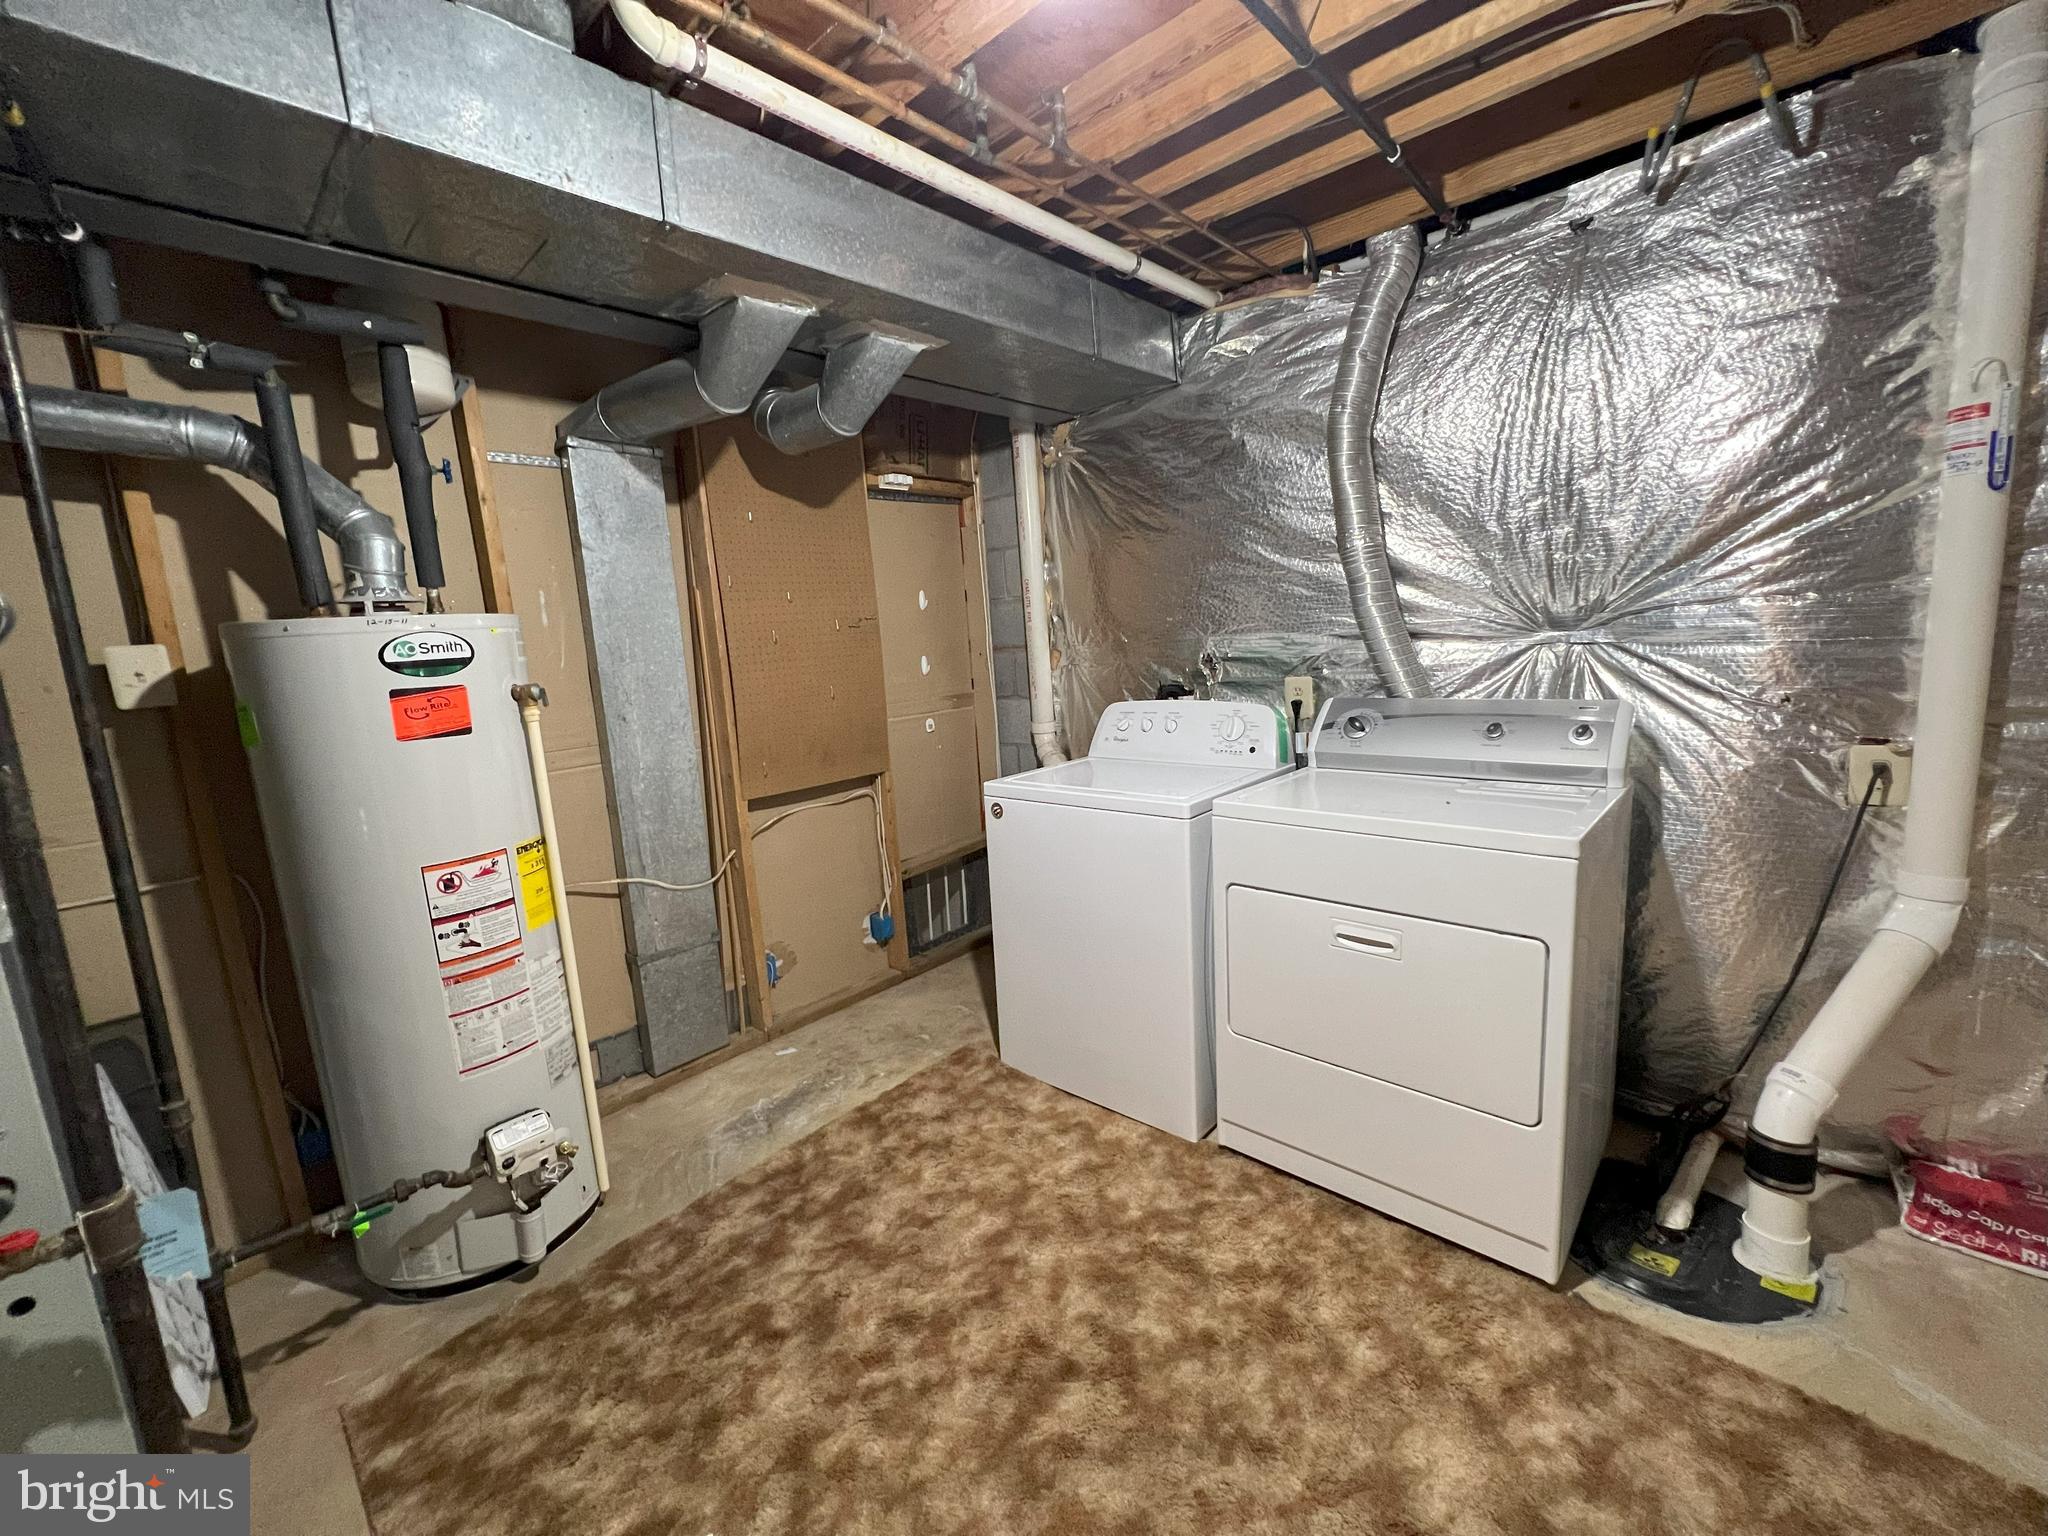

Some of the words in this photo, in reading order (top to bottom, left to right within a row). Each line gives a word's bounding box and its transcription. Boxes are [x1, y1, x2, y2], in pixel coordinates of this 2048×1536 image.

[419, 641, 463, 654] Smith
[405, 705, 428, 716] Flow
[430, 701, 450, 711] Rite
